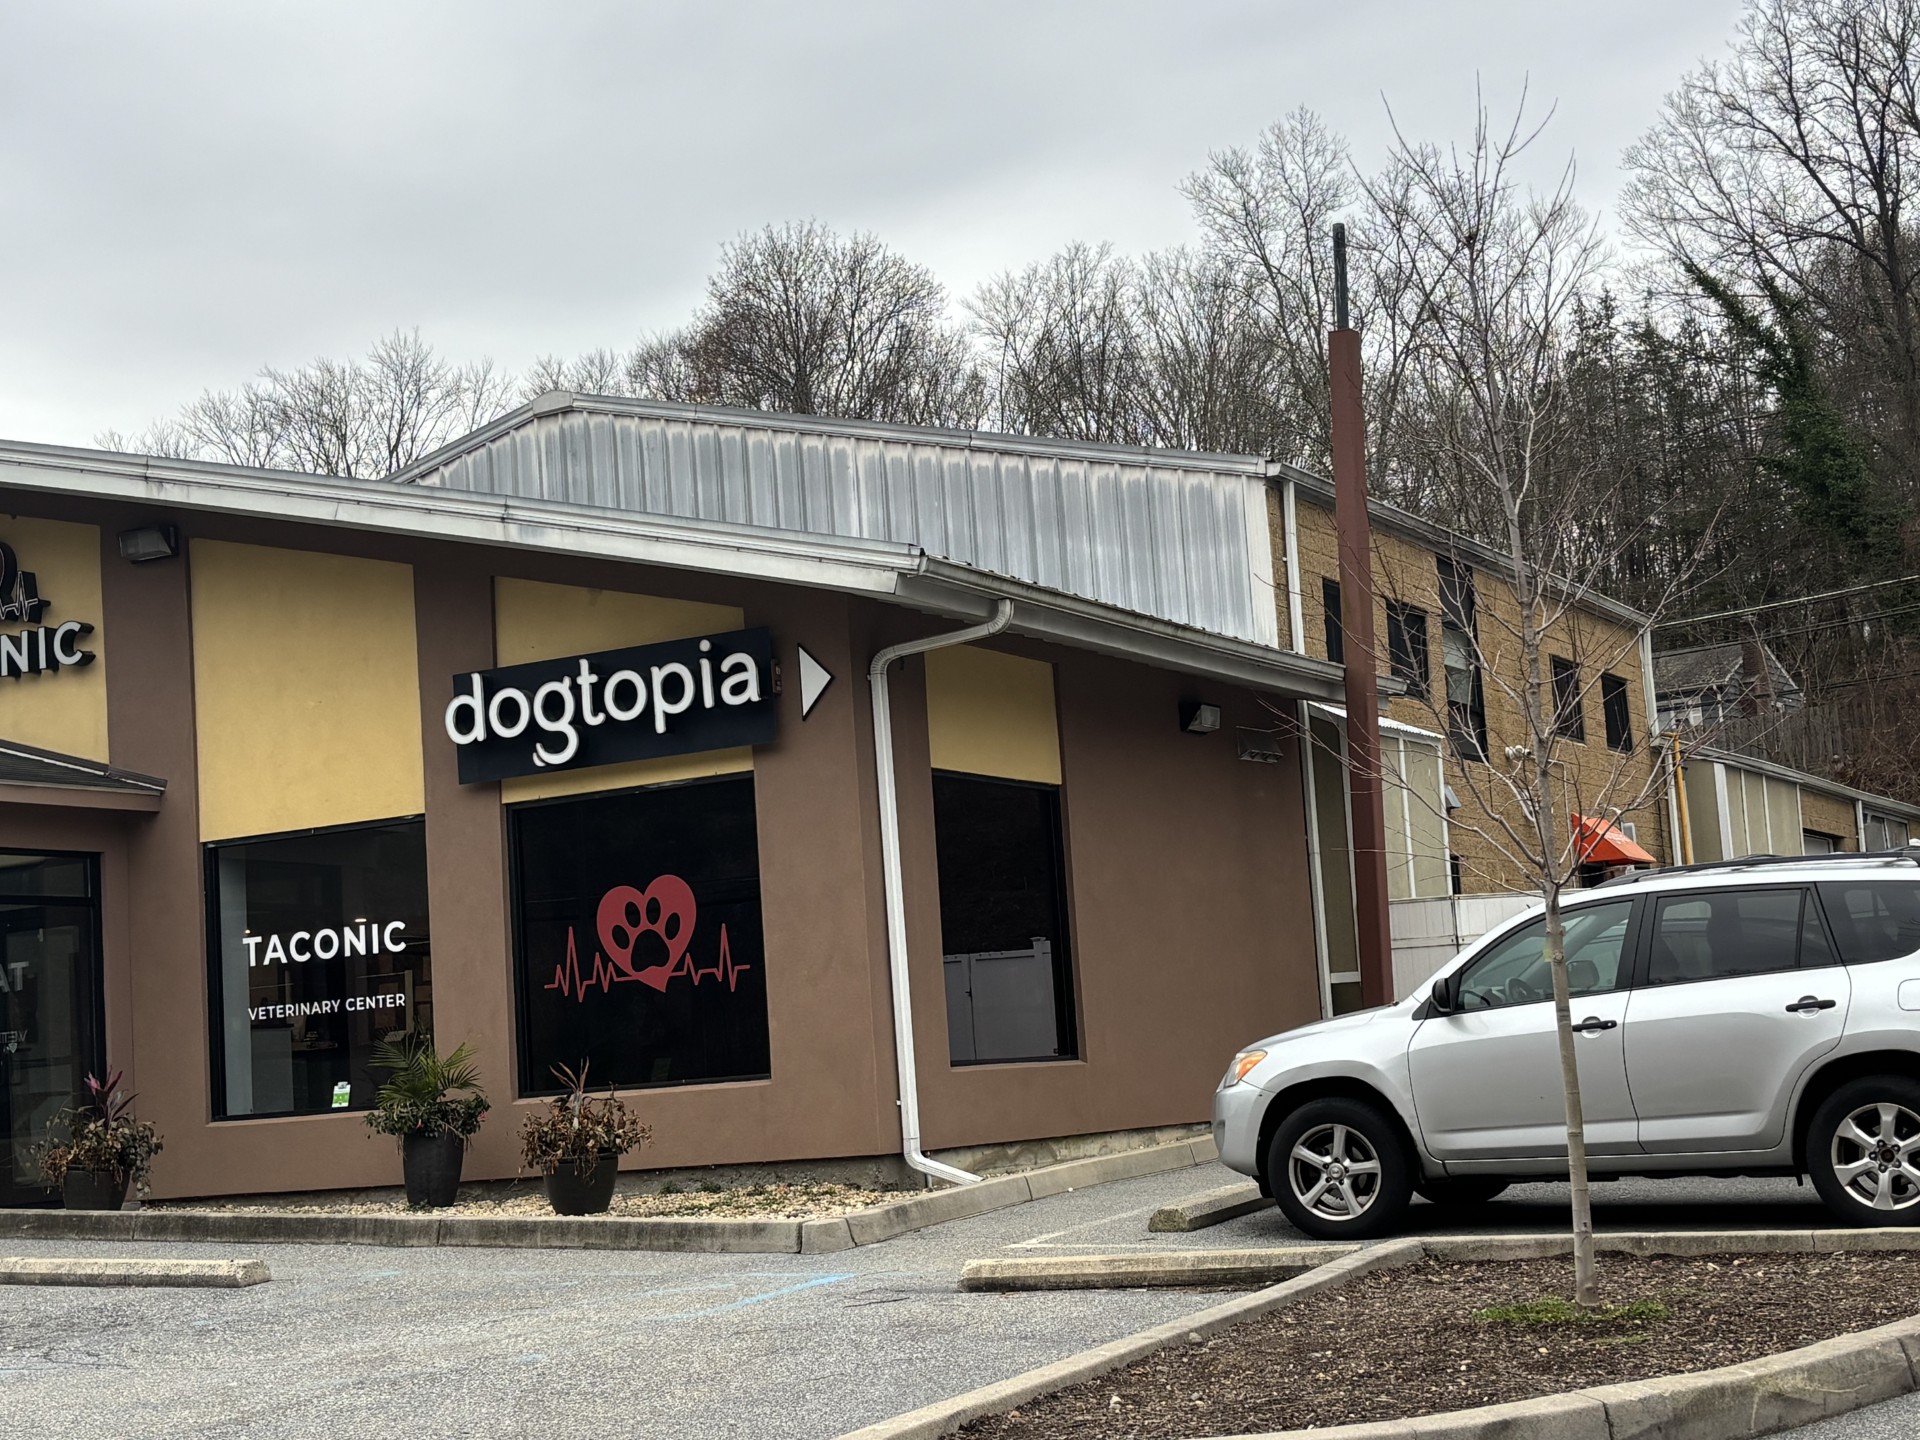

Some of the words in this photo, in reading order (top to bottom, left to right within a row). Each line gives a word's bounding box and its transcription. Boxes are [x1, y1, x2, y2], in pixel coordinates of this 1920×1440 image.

[0, 621, 83, 677] NIC
[444, 639, 762, 767] dogtopia
[242, 920, 407, 968] TACONIC
[248, 999, 341, 1021] VETERINARY
[345, 993, 406, 1012] CENTER
